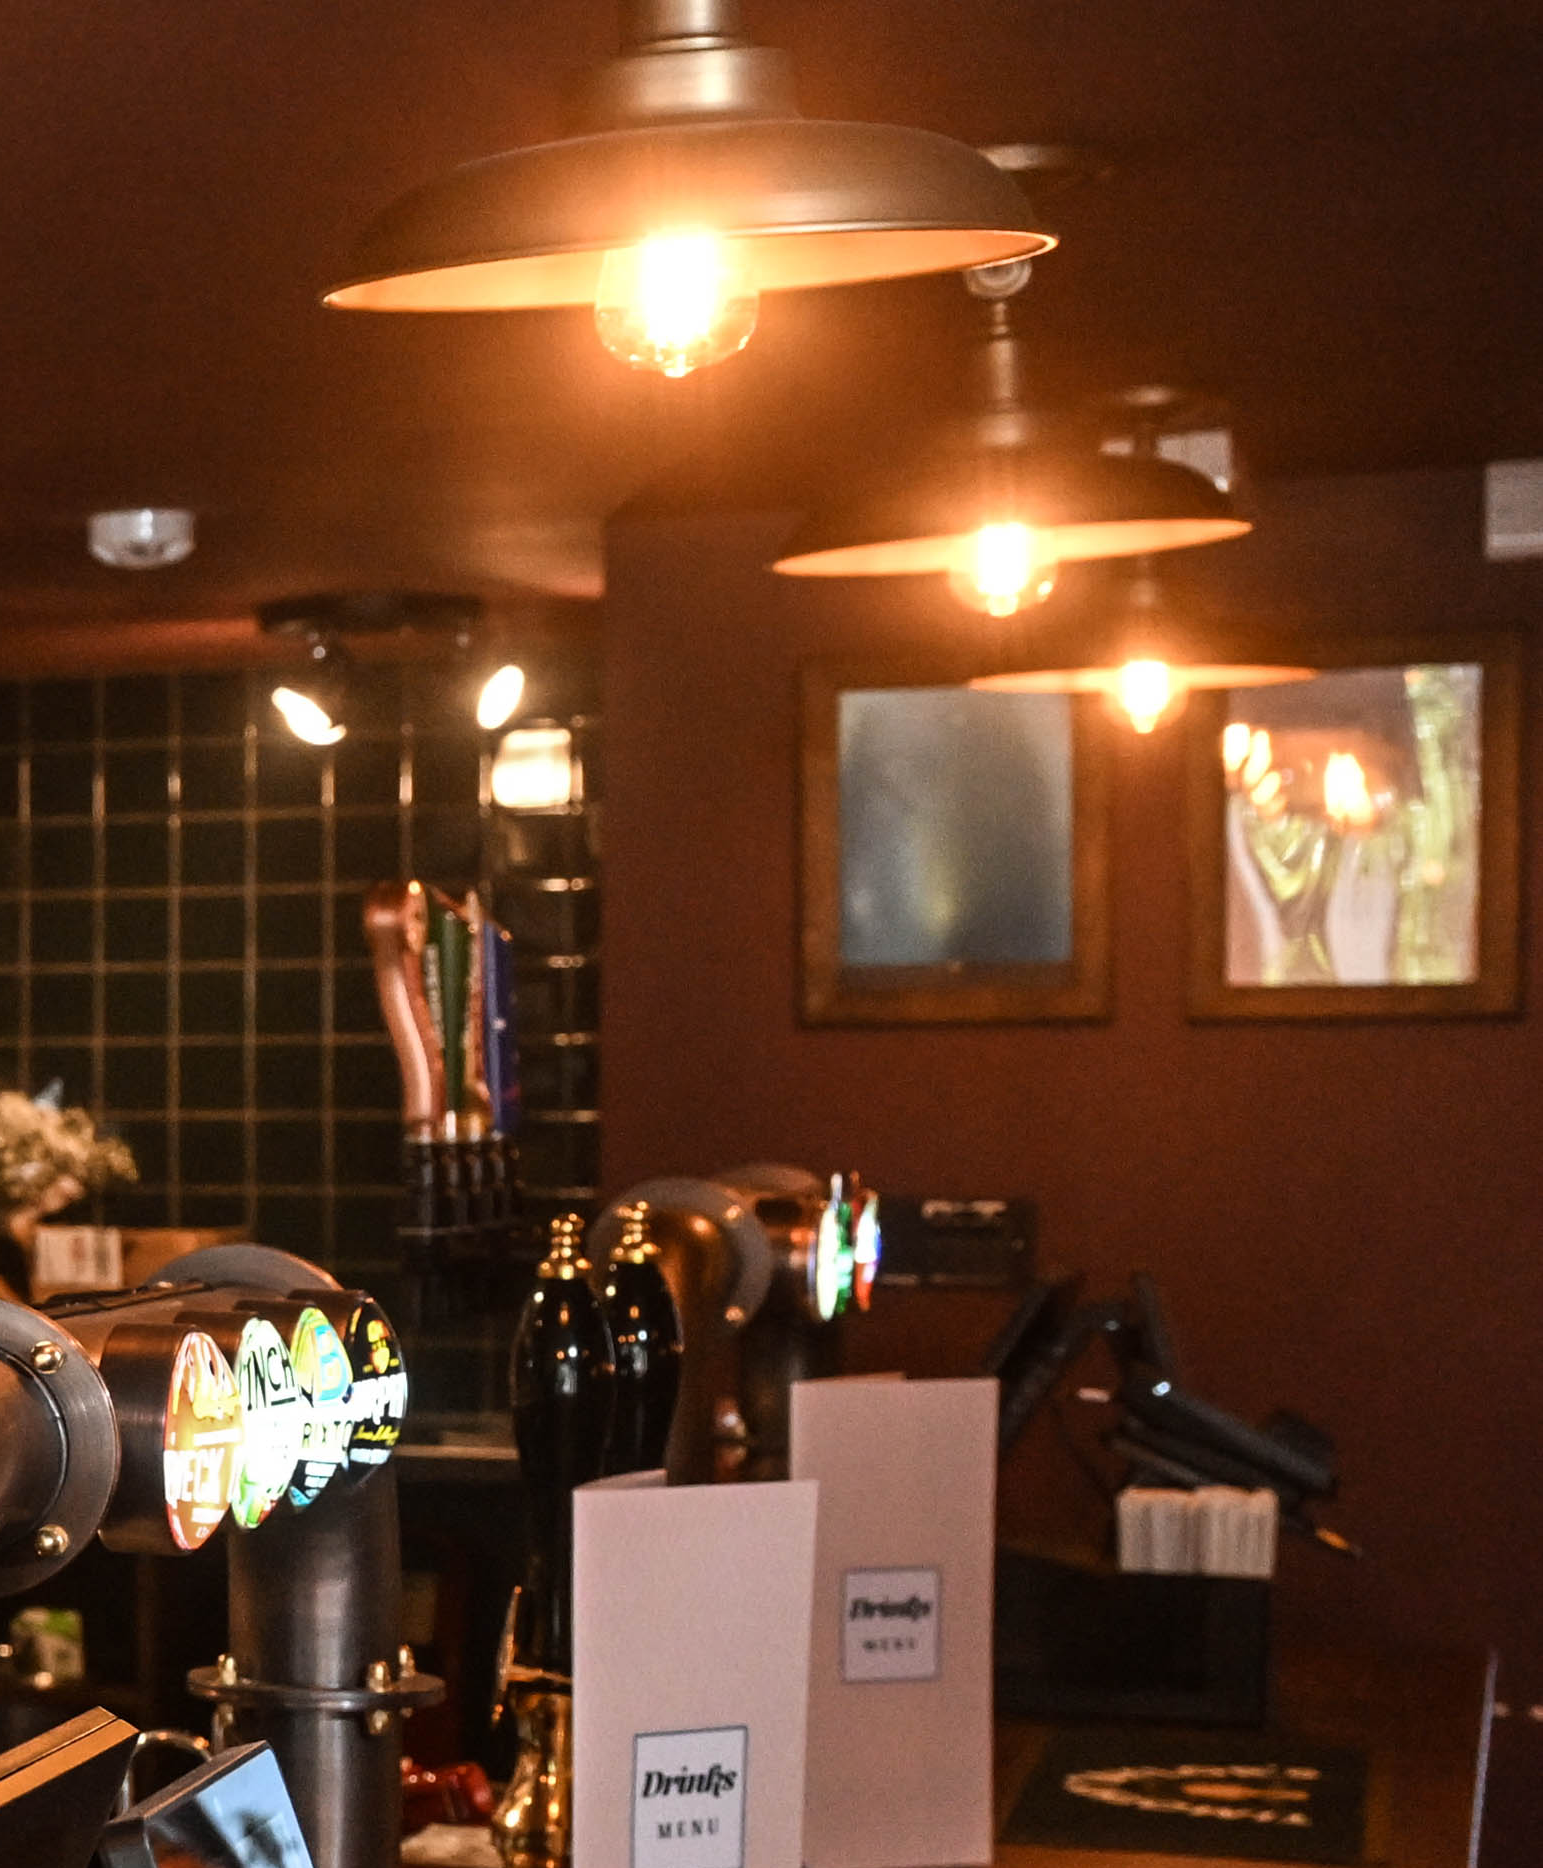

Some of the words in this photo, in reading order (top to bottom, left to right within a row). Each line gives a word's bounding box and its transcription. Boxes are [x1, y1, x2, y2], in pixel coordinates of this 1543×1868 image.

[244, 1340, 297, 1413] INCH
[301, 1420, 355, 1452] RIXTO
[641, 1763, 738, 1799] Drinks
[657, 1818, 720, 1841] MENU
